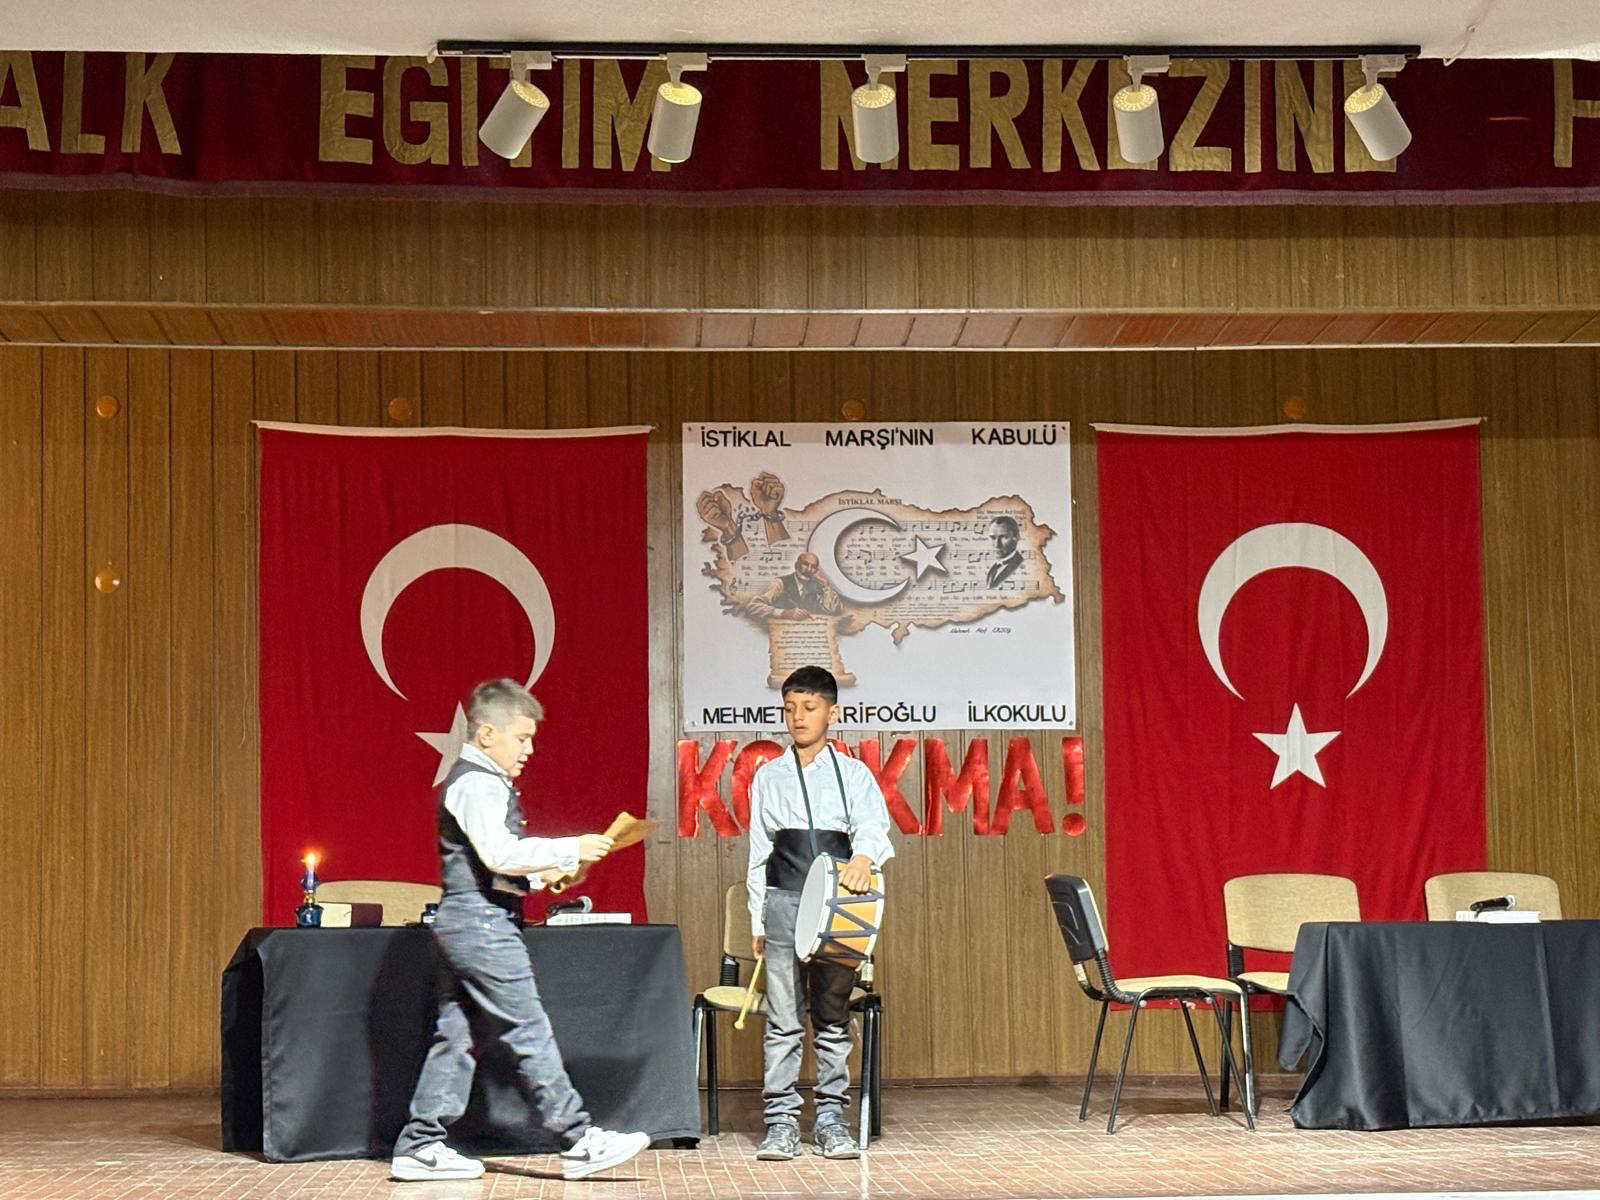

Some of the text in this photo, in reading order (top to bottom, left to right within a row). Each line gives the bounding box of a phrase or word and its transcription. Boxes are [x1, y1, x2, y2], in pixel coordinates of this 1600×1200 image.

[700, 424, 1058, 450] İSTİKLAL MARŞI'NIN KABULÜ
[703, 700, 1066, 725] MEHMET RİFOĞLU İLKOKULU
[677, 738, 1088, 837] KOKMA!
